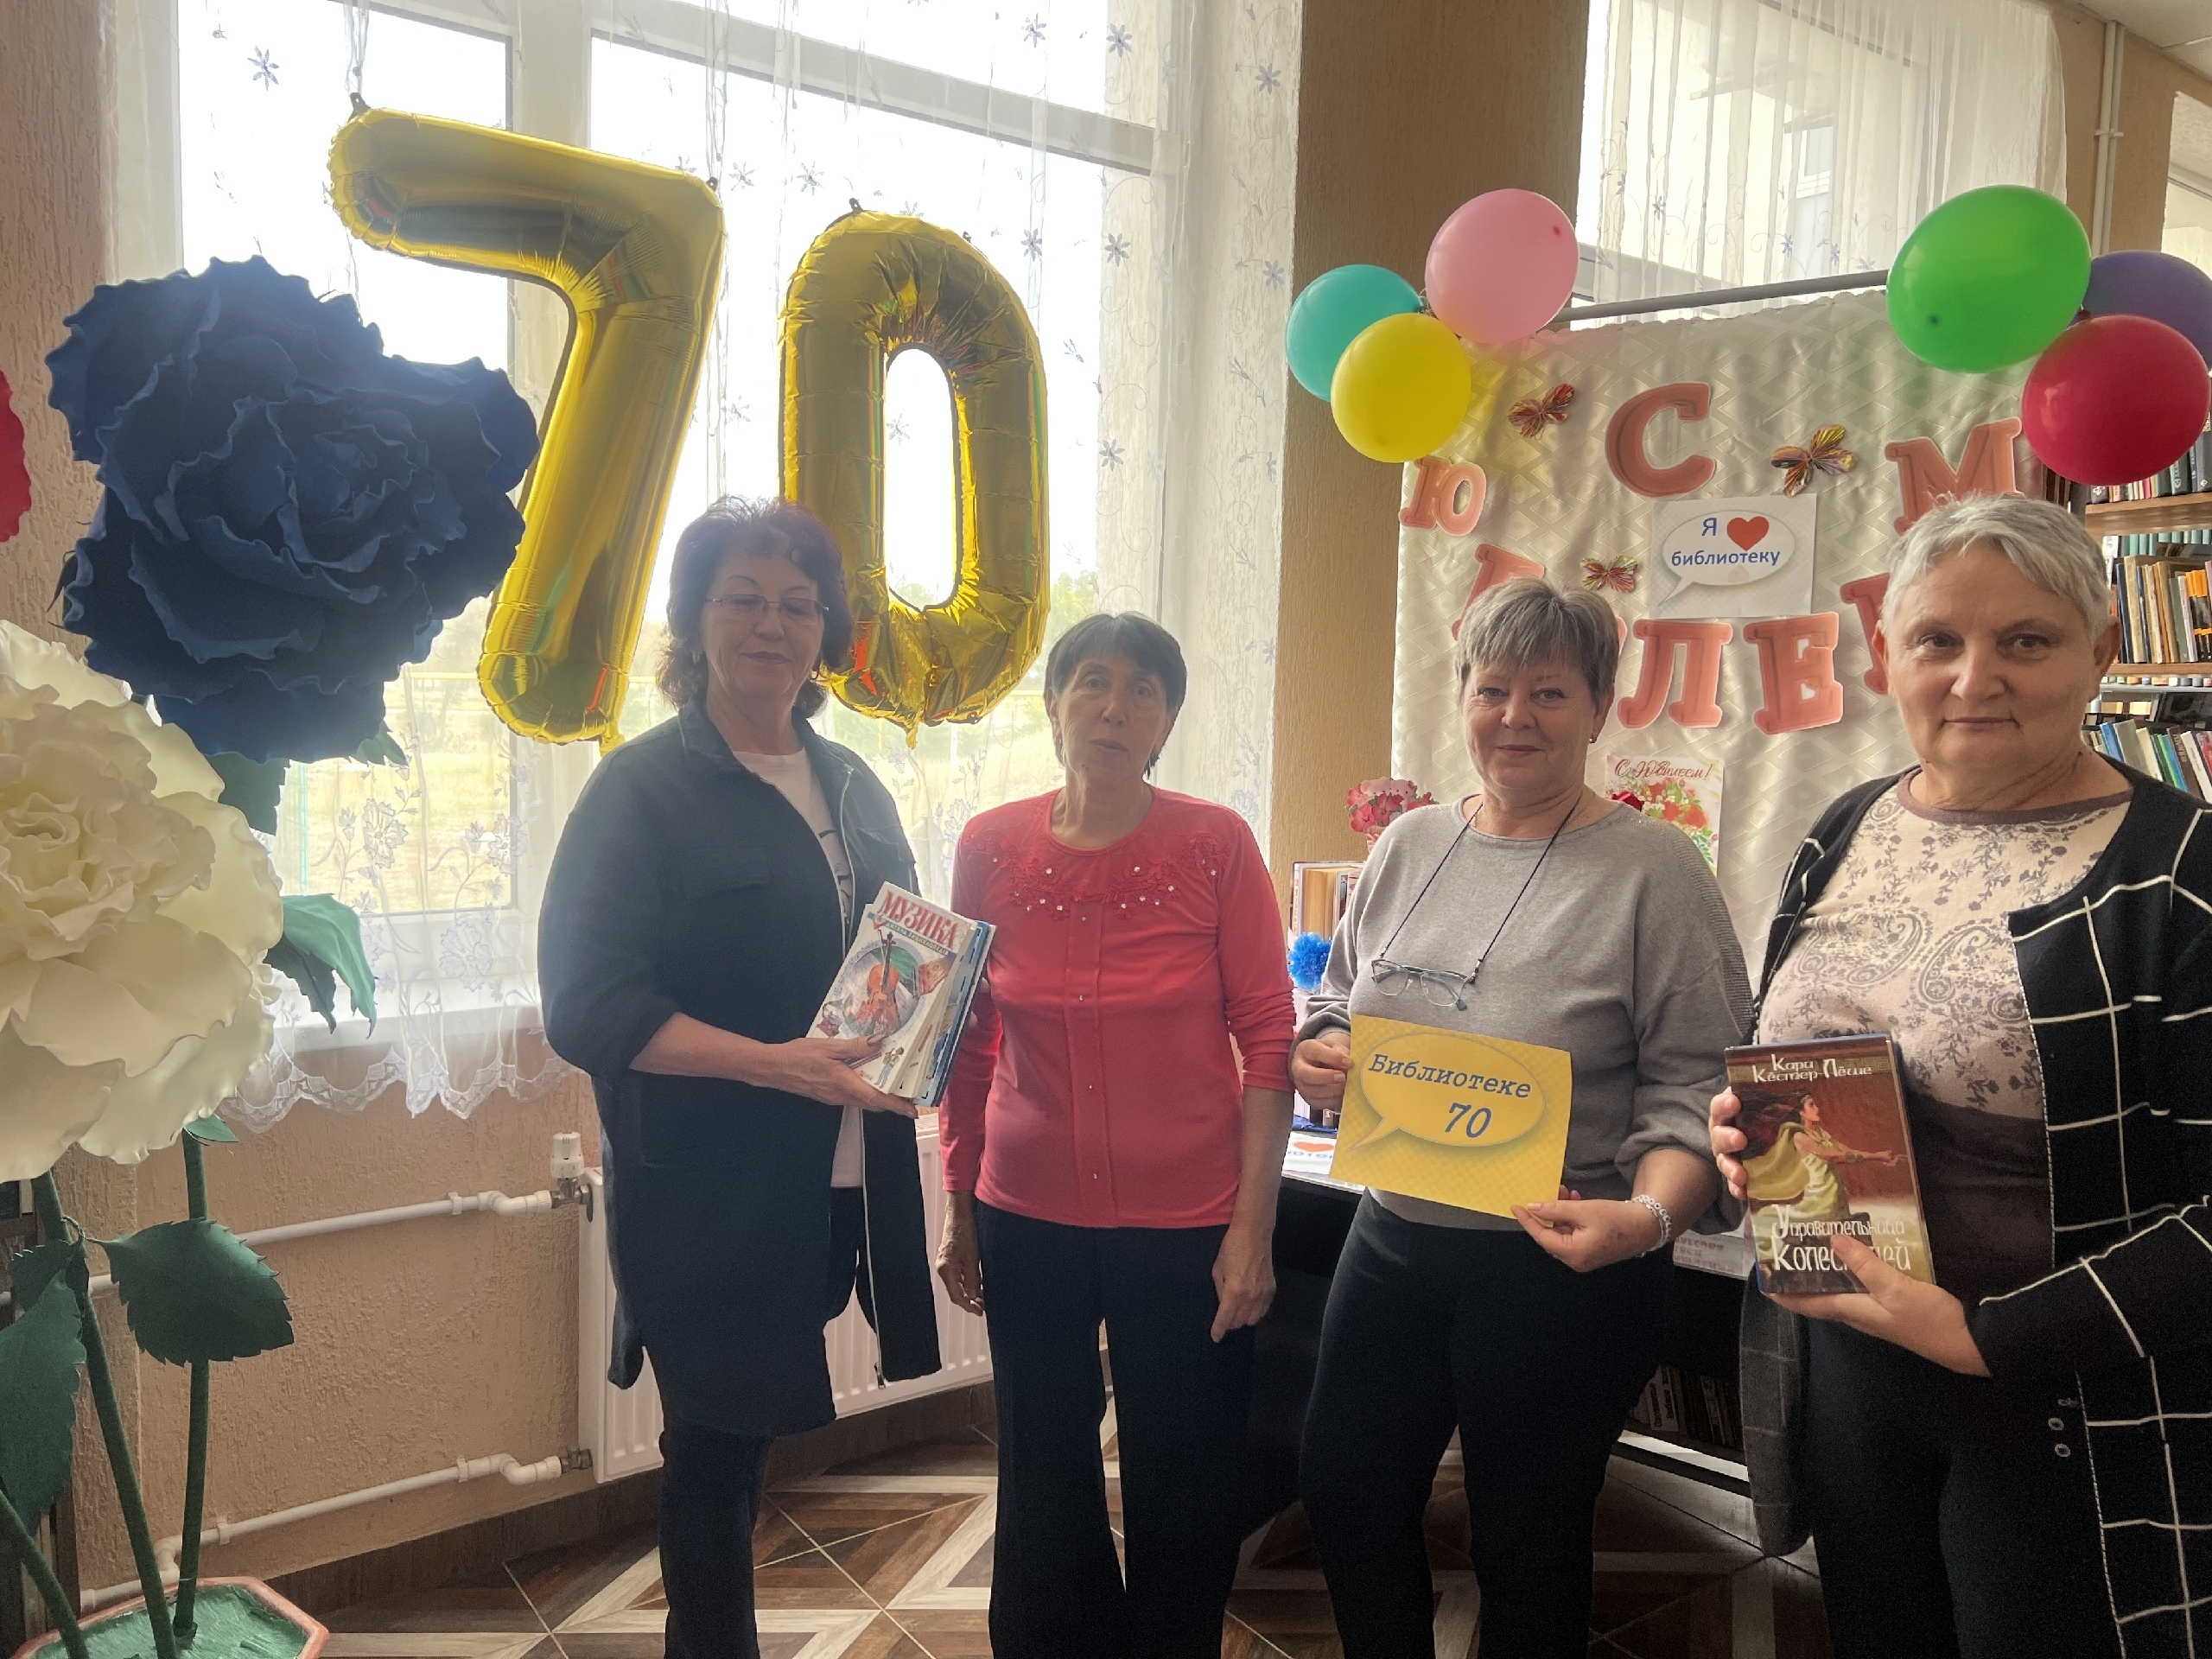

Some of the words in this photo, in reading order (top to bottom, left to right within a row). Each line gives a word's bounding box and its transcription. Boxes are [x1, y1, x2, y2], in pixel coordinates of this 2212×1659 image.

[1605, 381, 1716, 499] С
[1701, 517, 1717, 537] Я
[1671, 550, 1781, 567] библиотеку
[1614, 759, 1630, 778] С
[876, 890, 959, 950] МУЗИКА
[1368, 1053, 1532, 1099] Библиотеке
[1771, 1053, 1814, 1071] Кари
[1444, 1102, 1493, 1139] 70
[1771, 1204, 1905, 1242] Управительница
